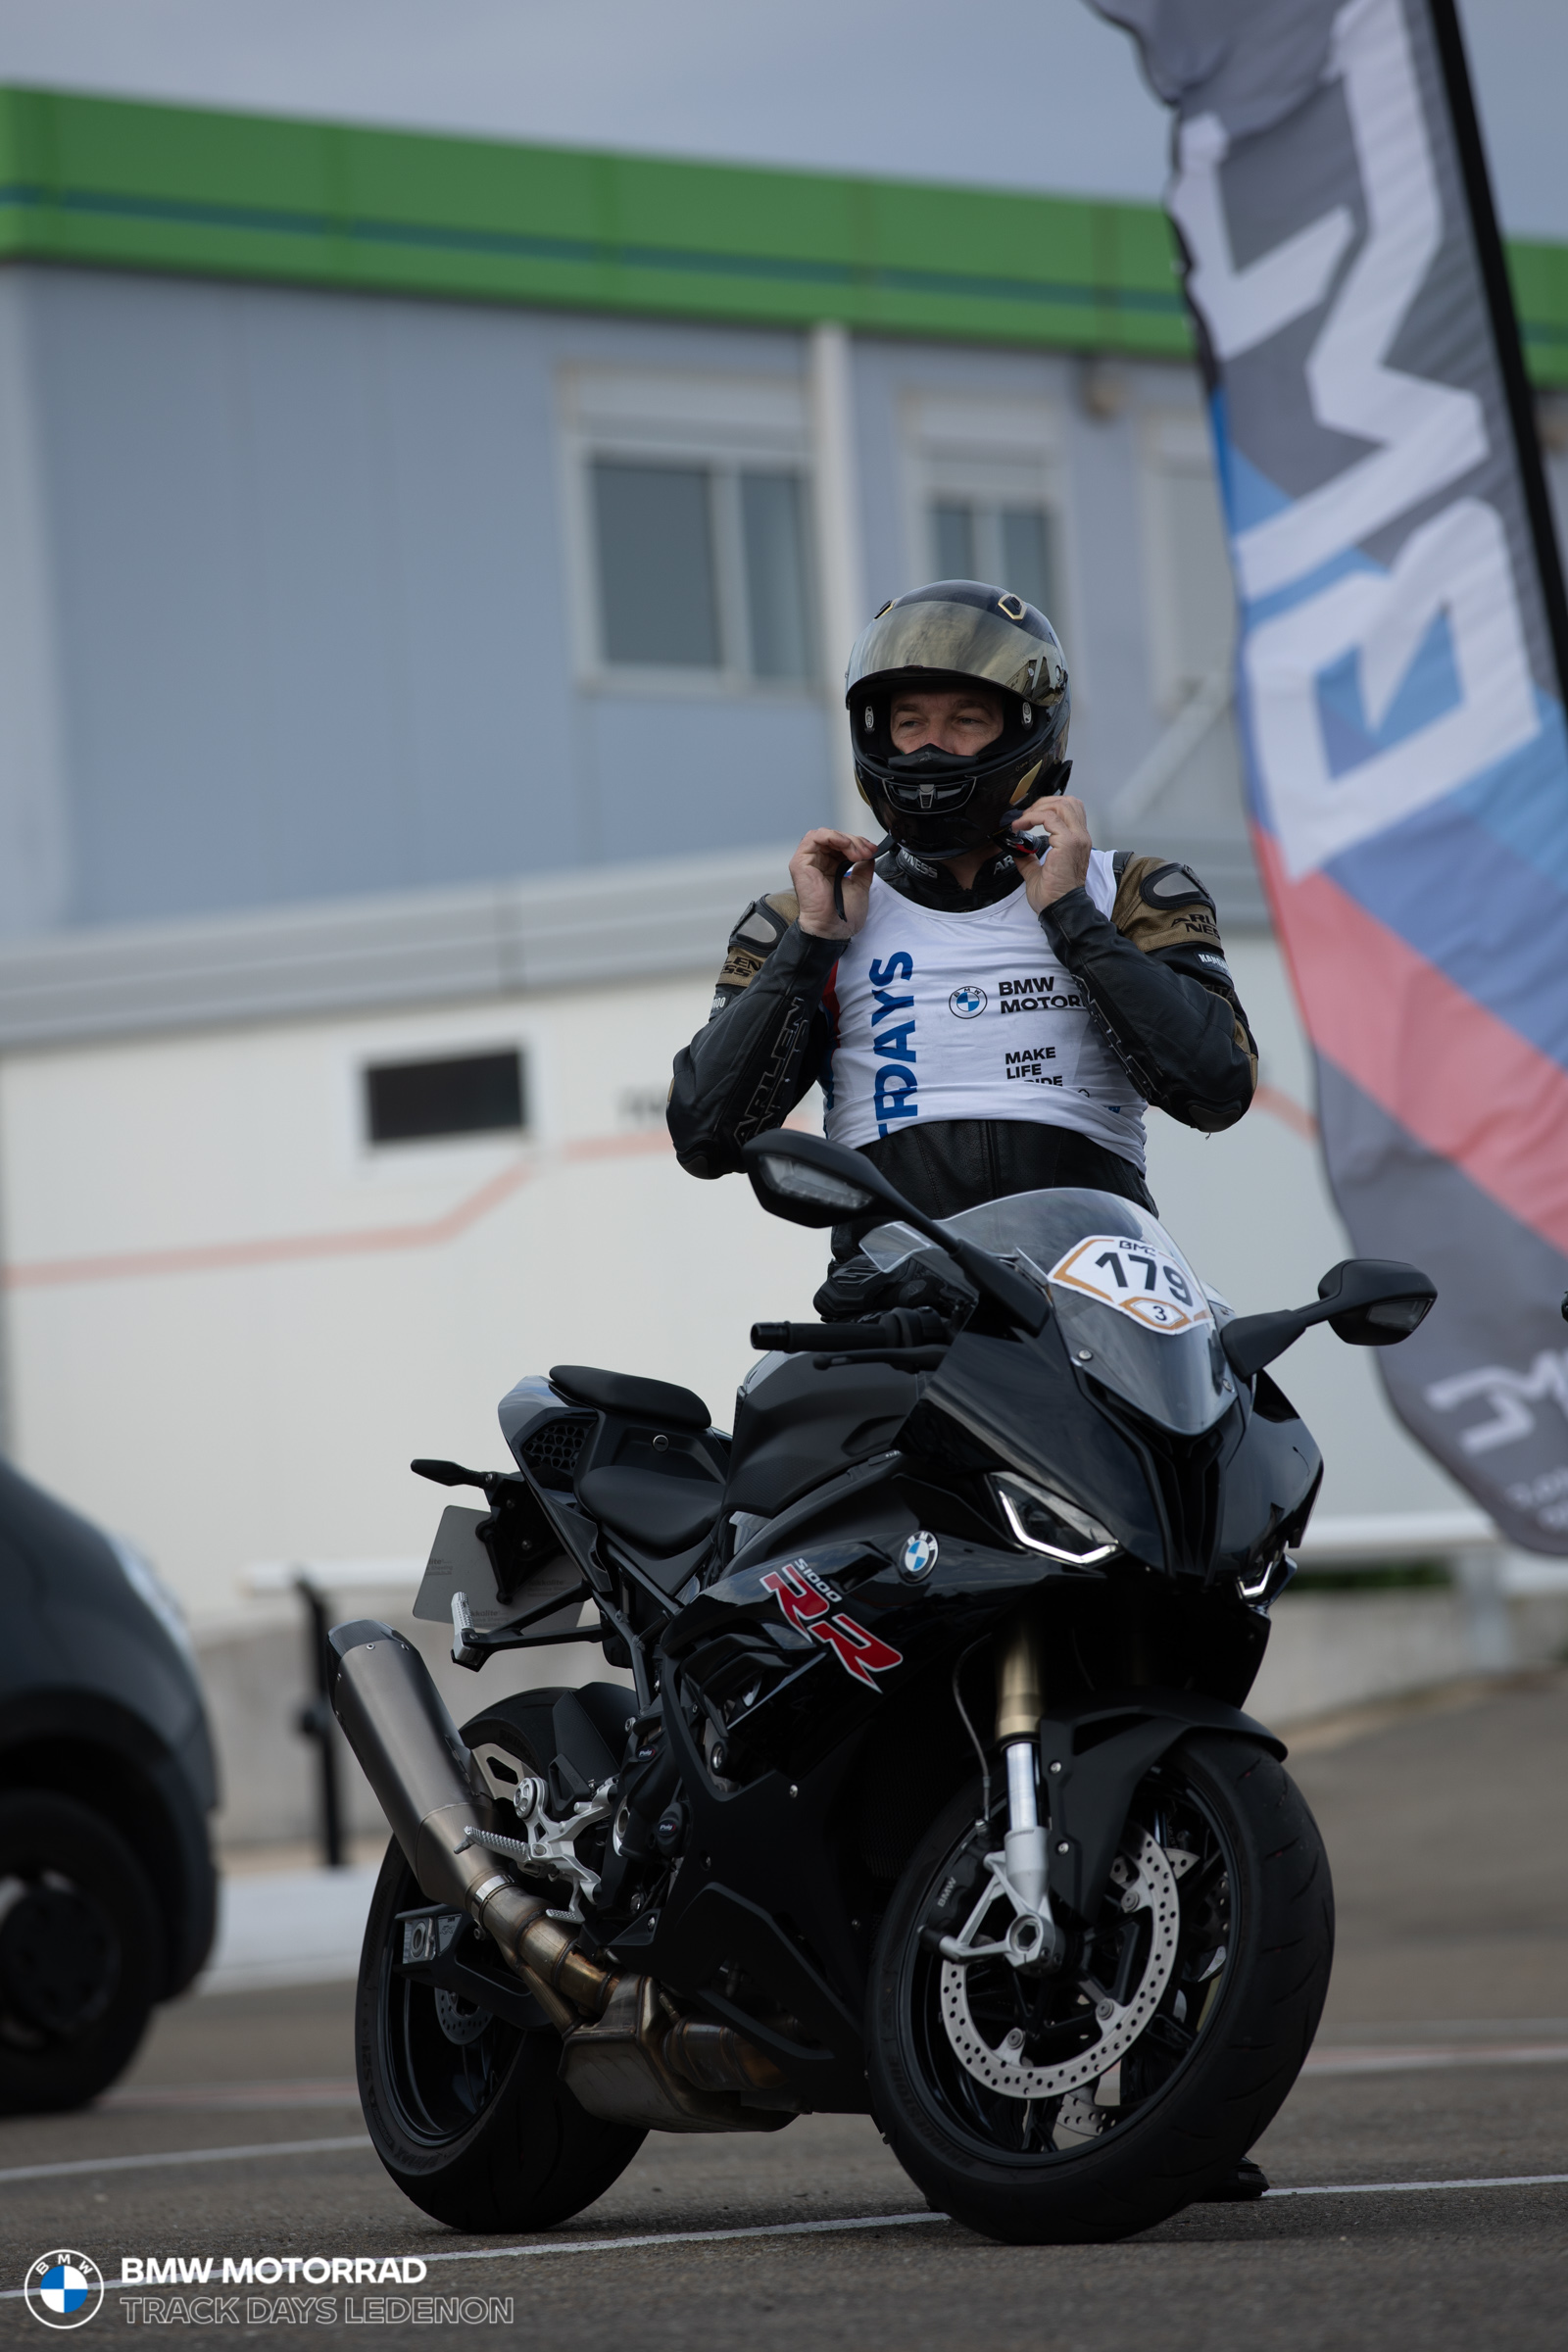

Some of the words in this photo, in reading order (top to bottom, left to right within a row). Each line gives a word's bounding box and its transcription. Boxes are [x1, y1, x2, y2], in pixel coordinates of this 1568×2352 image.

[998, 976, 1055, 996] BMW
[1000, 994, 1086, 1014] MOTOR
[1005, 1046, 1056, 1065] MAKE
[1005, 1062, 1042, 1079] LIFE
[1095, 1251, 1194, 1307] 179
[1152, 1305, 1167, 1322] 3
[794, 1556, 843, 1603] S1000
[760, 1563, 904, 1694] RR
[937, 1876, 956, 1908] BMW
